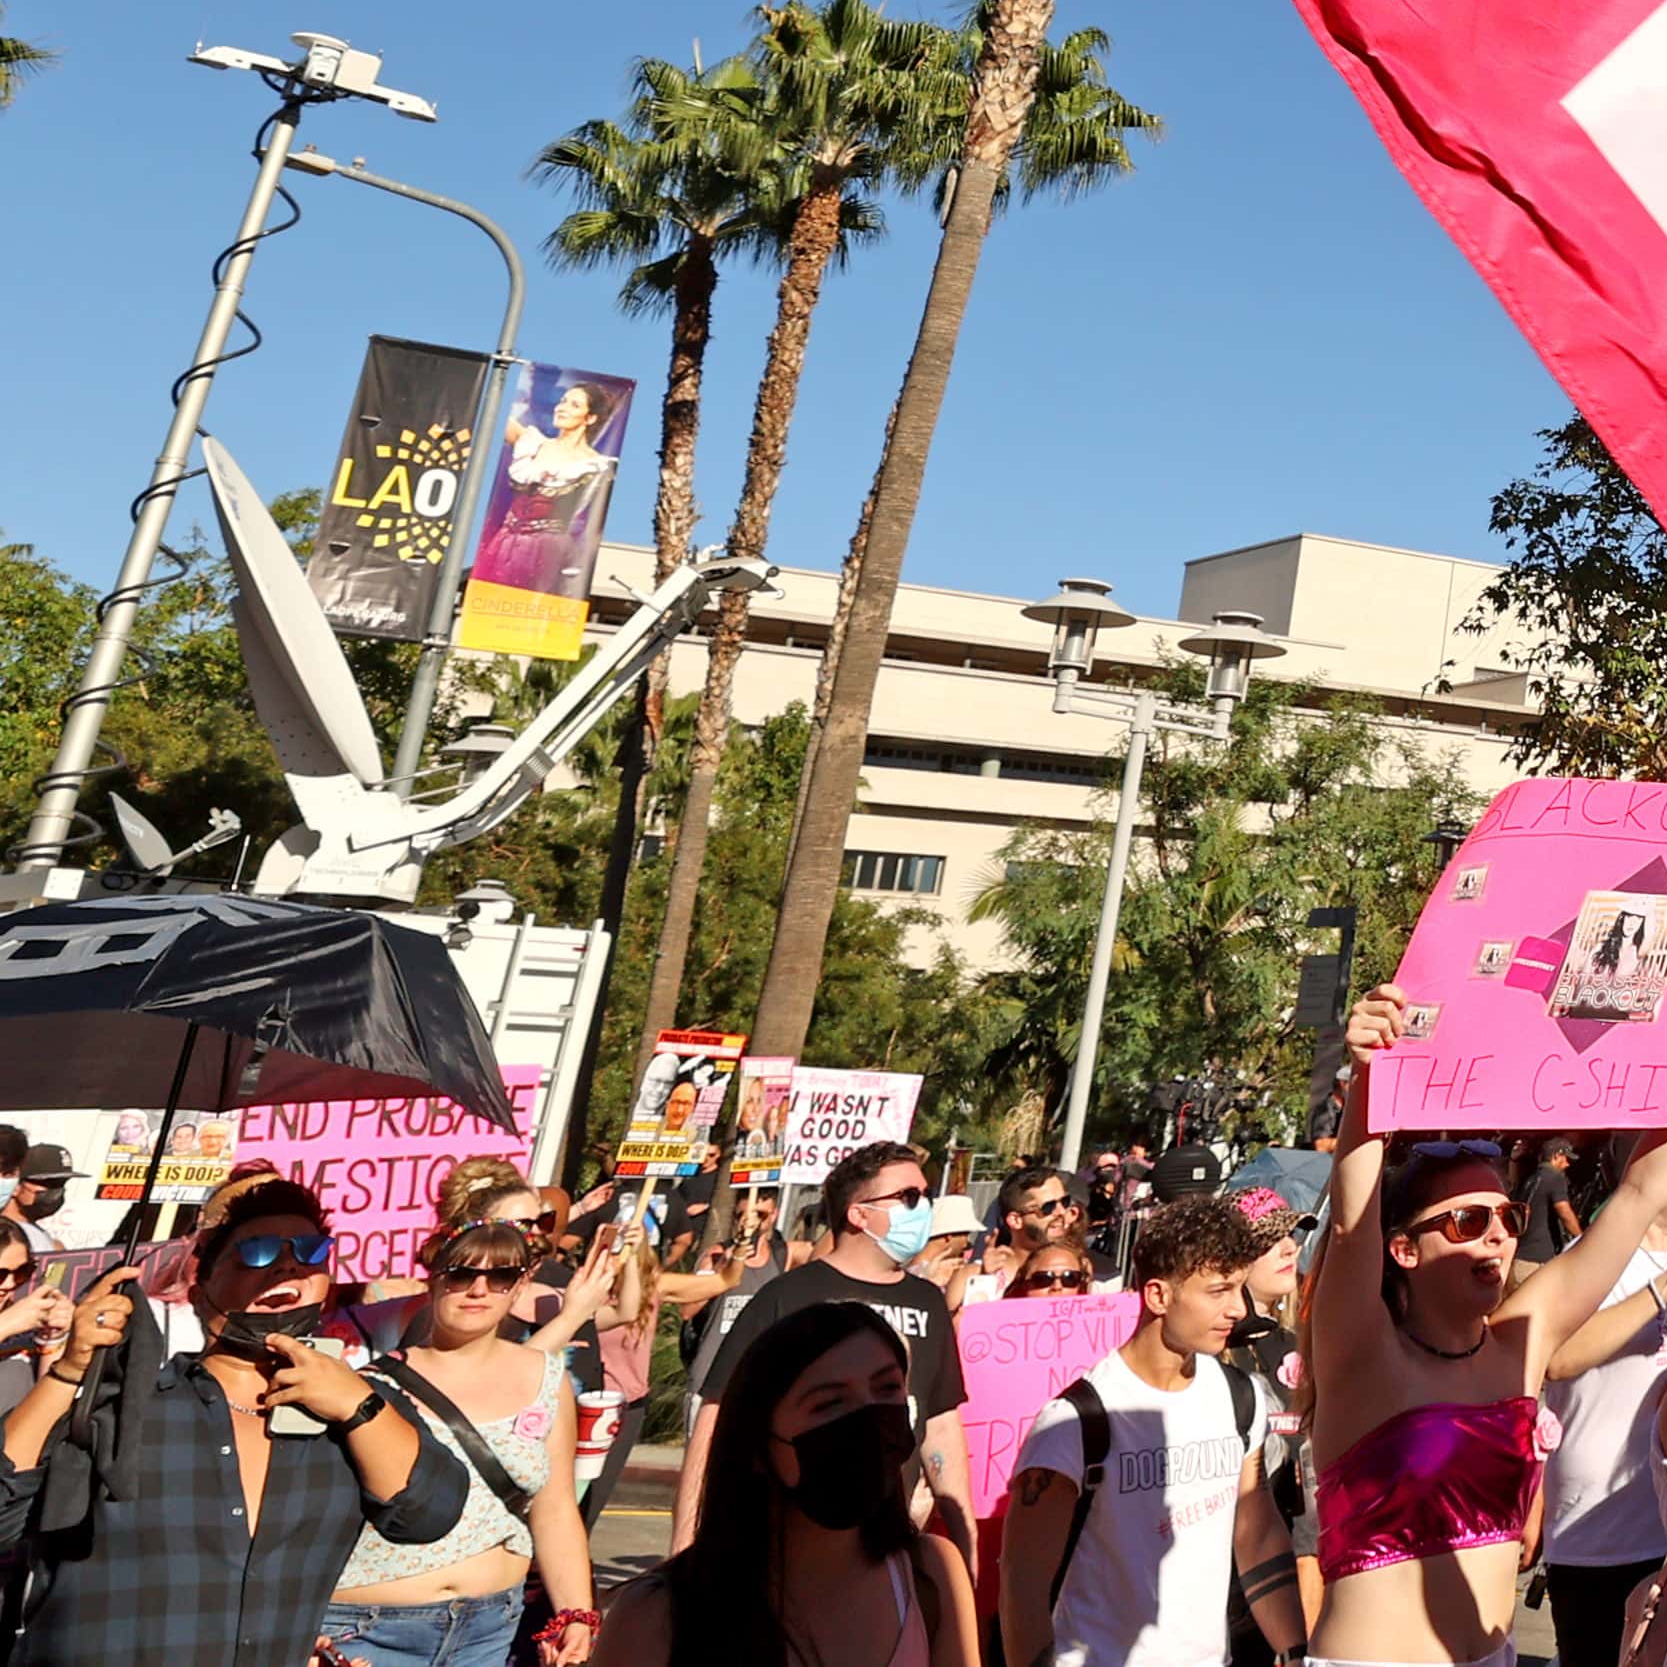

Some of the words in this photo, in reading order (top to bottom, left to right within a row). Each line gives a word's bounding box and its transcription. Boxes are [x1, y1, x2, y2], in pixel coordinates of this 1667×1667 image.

[332, 457, 457, 518] LAO
[1382, 1053, 1494, 1119] THE
[238, 1101, 329, 1142] END
[799, 1117, 867, 1141] GOOD
[164, 1164, 182, 1181] IS
[183, 1166, 225, 1182] DOJ?
[620, 1143, 654, 1159] WHERE
[654, 1143, 666, 1158] IS
[963, 1318, 1074, 1365] @STOP
[1119, 1436, 1244, 1495] DOGPOUND
